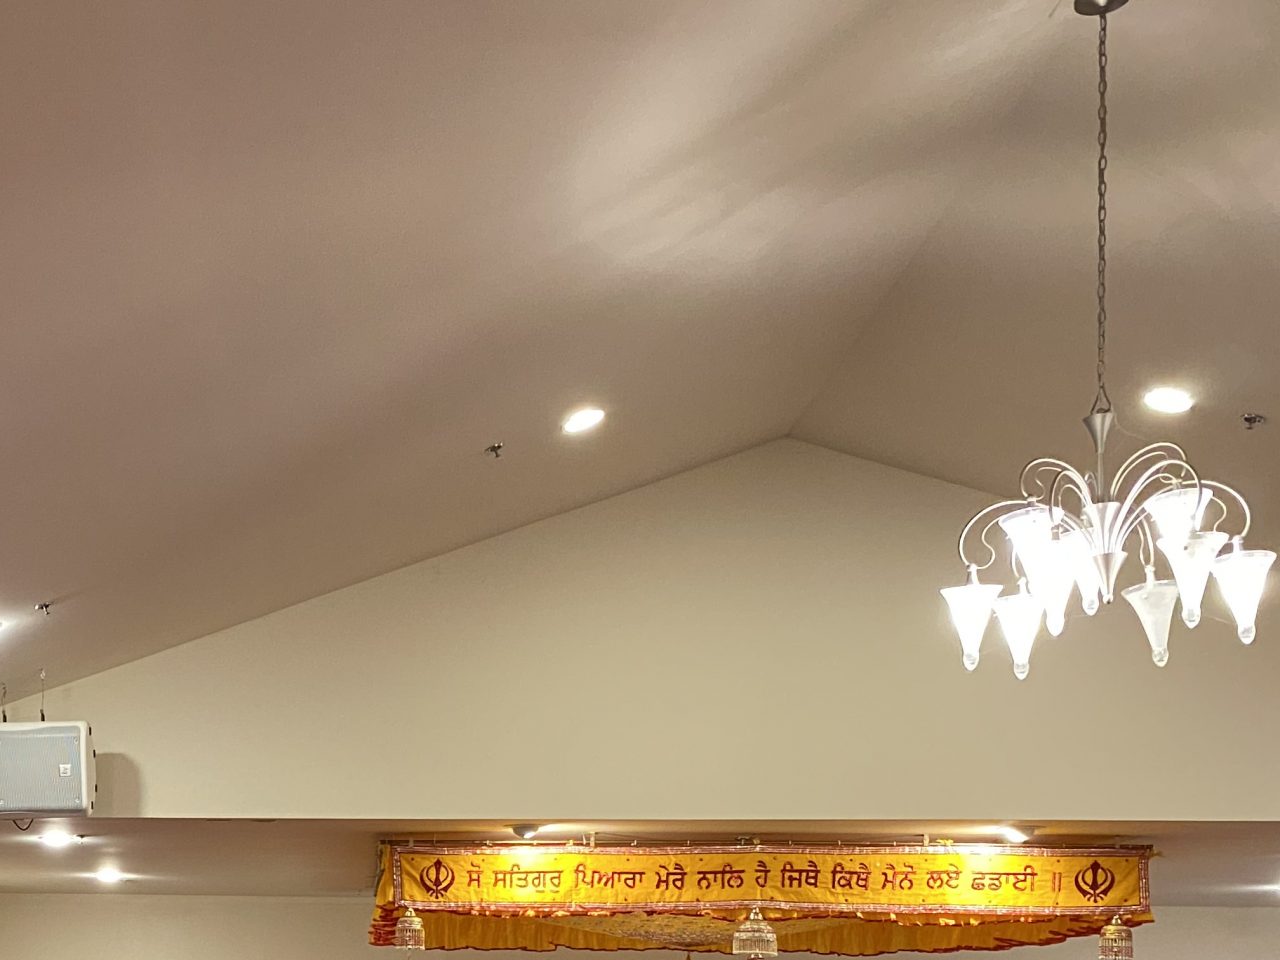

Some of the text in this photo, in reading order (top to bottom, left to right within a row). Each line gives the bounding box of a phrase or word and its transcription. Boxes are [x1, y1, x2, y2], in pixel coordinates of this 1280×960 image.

[466, 861, 484, 889] ਸੋ
[574, 863, 646, 889] ਪਿਆਰਾ
[655, 862, 687, 890] ਮੇਰੈ
[696, 863, 746, 890] ਨਾਲਿ
[754, 860, 771, 888] ਹੈ
[780, 860, 821, 888] ਜਿਥੈ
[831, 862, 872, 891] ਕਿਥੈ
[881, 862, 918, 891] ਮੈਨੋ
[926, 863, 962, 889] ਲਏ
